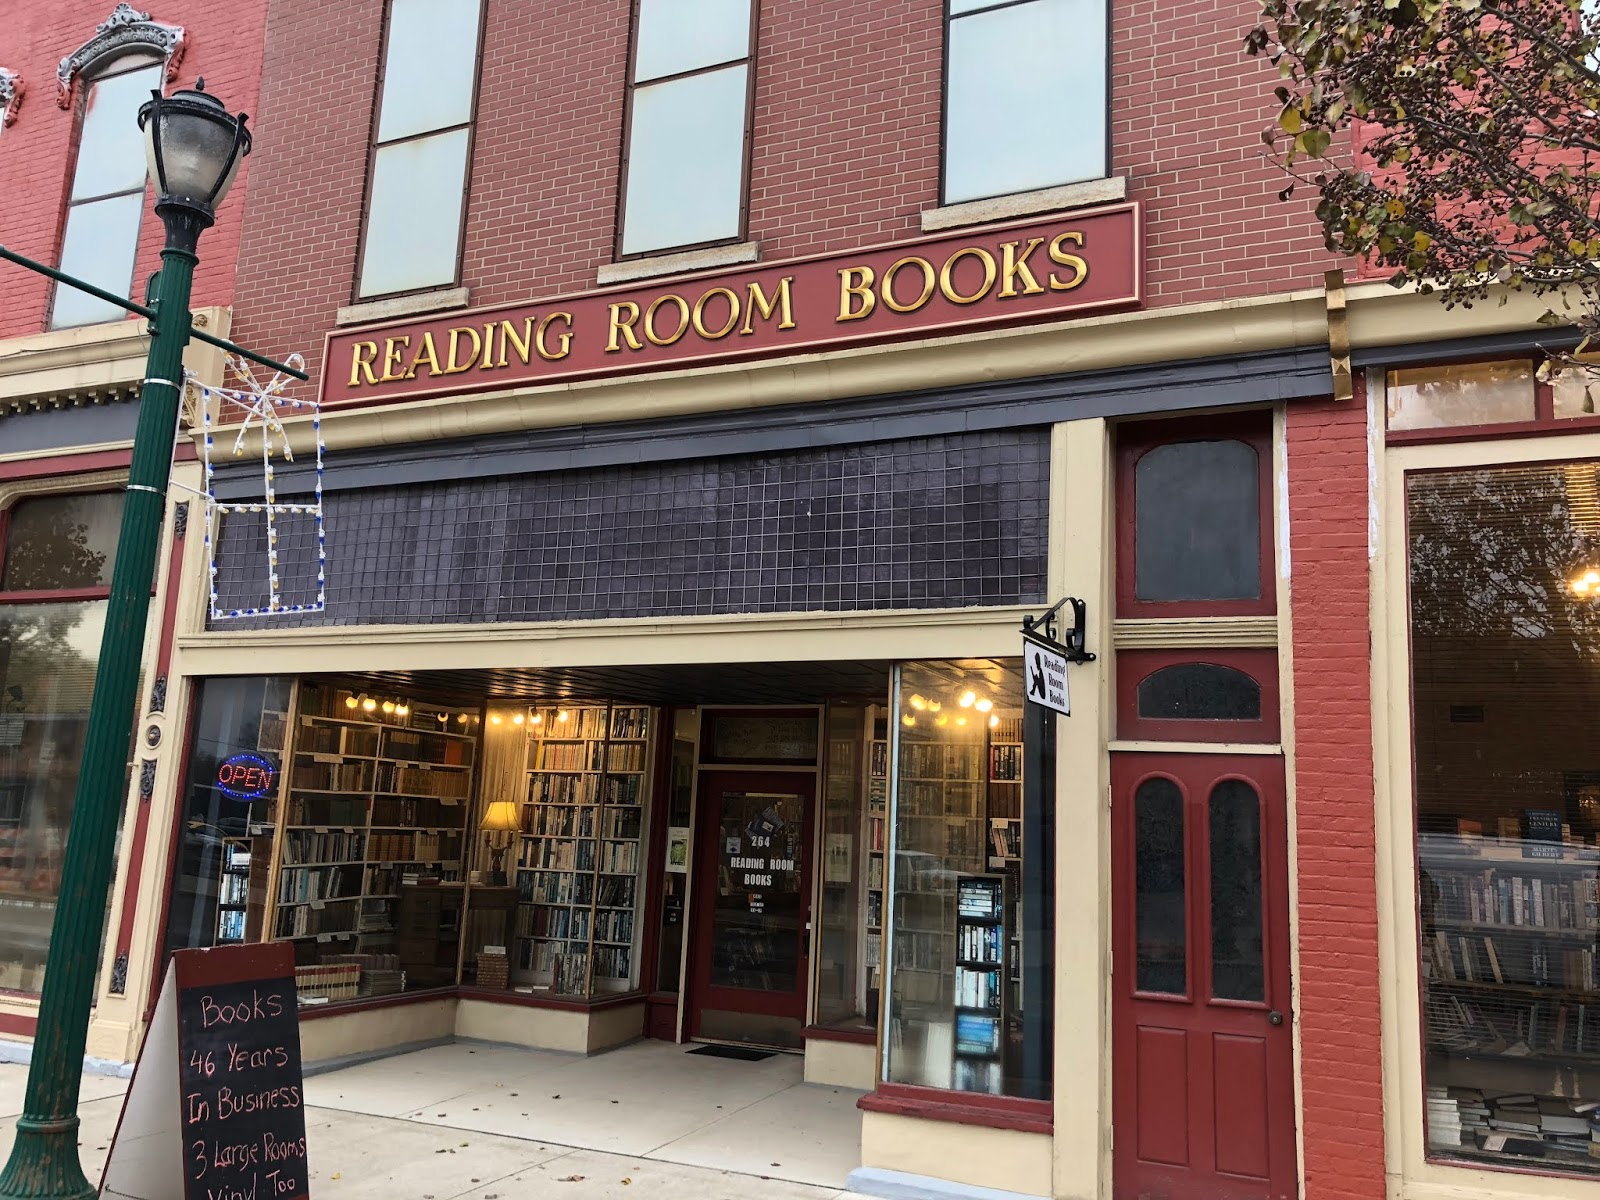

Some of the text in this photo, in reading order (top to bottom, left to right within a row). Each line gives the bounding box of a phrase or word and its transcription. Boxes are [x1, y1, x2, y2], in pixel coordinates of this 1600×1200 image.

[347, 232, 1088, 387] READING ROOM BOOKS
[1043, 654, 1065, 677] Reading
[1048, 673, 1064, 690] Room
[1049, 689, 1065, 707] Books
[219, 764, 273, 790] OPEN
[752, 836, 770, 847] 264
[730, 857, 794, 871] READING ROOM
[744, 874, 772, 886] BOOKS
[200, 989, 283, 1028] Books
[190, 1043, 289, 1077] 46 Years
[187, 1085, 300, 1124] In Business
[192, 1132, 306, 1180] 3 Large Rooms
[265, 1170, 296, 1197] Too
